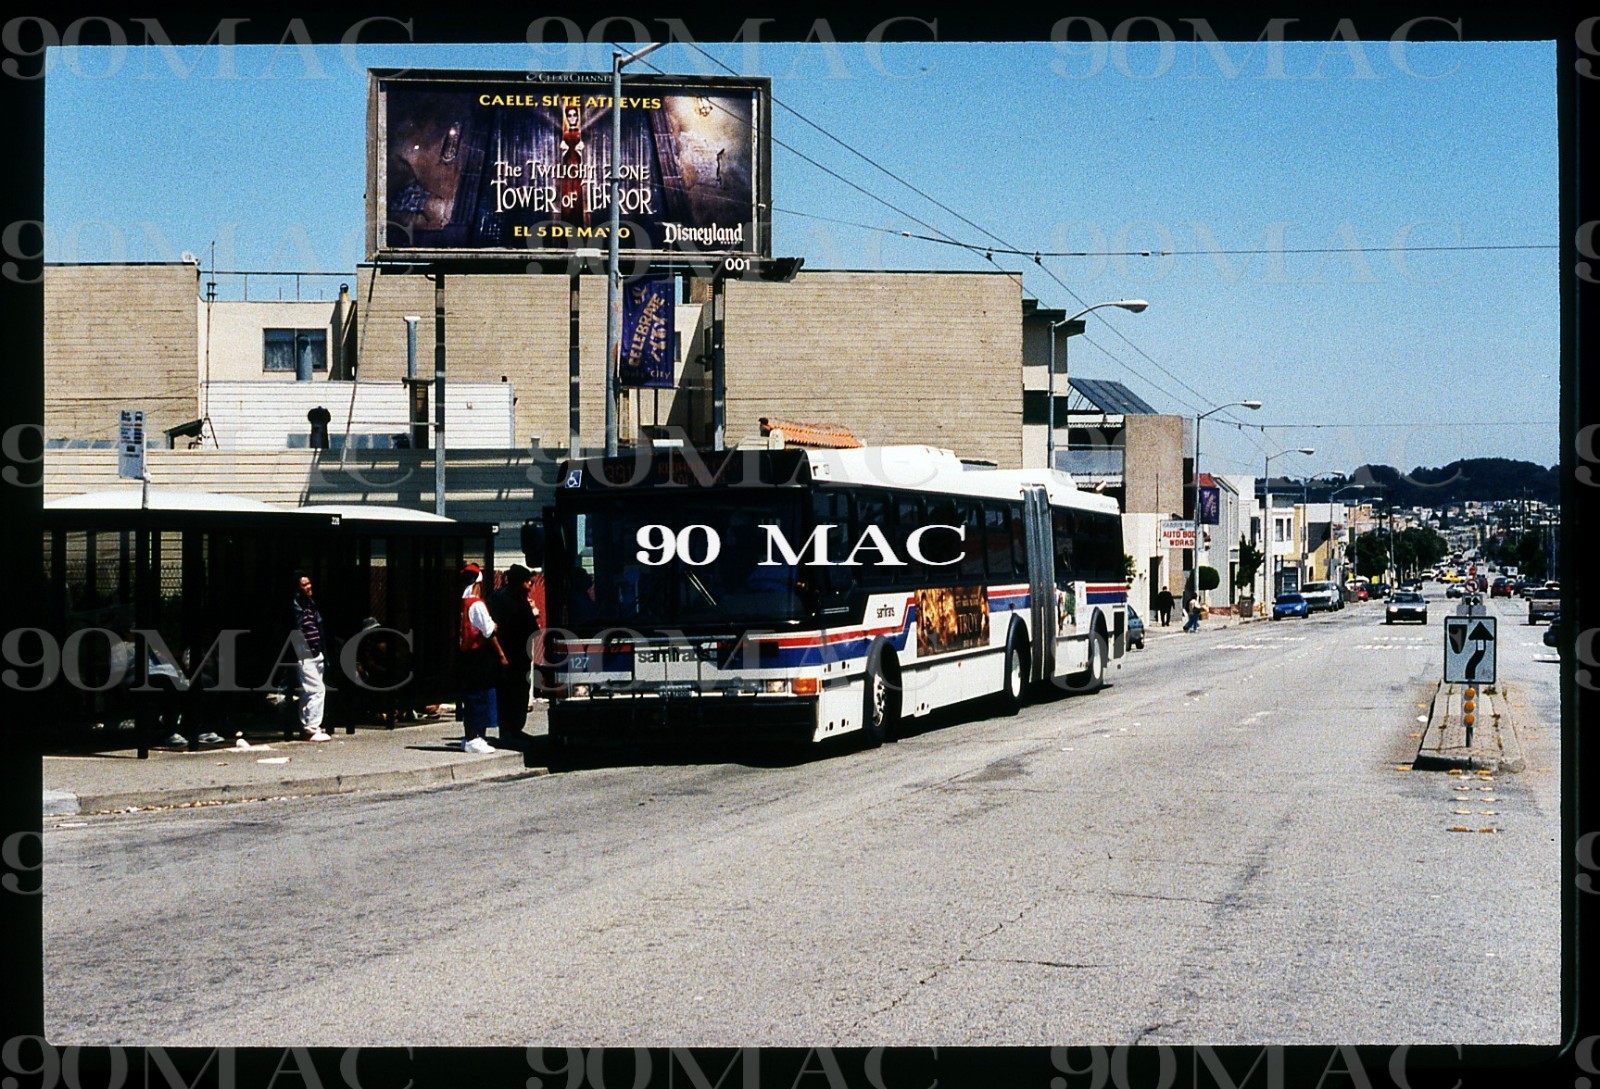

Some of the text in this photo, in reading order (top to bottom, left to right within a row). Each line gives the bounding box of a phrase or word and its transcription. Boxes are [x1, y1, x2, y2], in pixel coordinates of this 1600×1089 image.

[479, 94, 538, 107] CAELE,
[542, 95, 558, 107] SI
[561, 96, 581, 107] TE
[494, 160, 650, 181] The TWILIGHT ZONE
[491, 180, 561, 213] TOWER
[581, 179, 654, 215] TERROR
[513, 226, 533, 237] EL
[537, 226, 547, 237] 5
[551, 226, 573, 238] DE
[662, 222, 743, 245] Disneyland
[725, 258, 750, 271] 001
[1163, 530, 1181, 538] AUTO
[570, 657, 590, 669] 127
